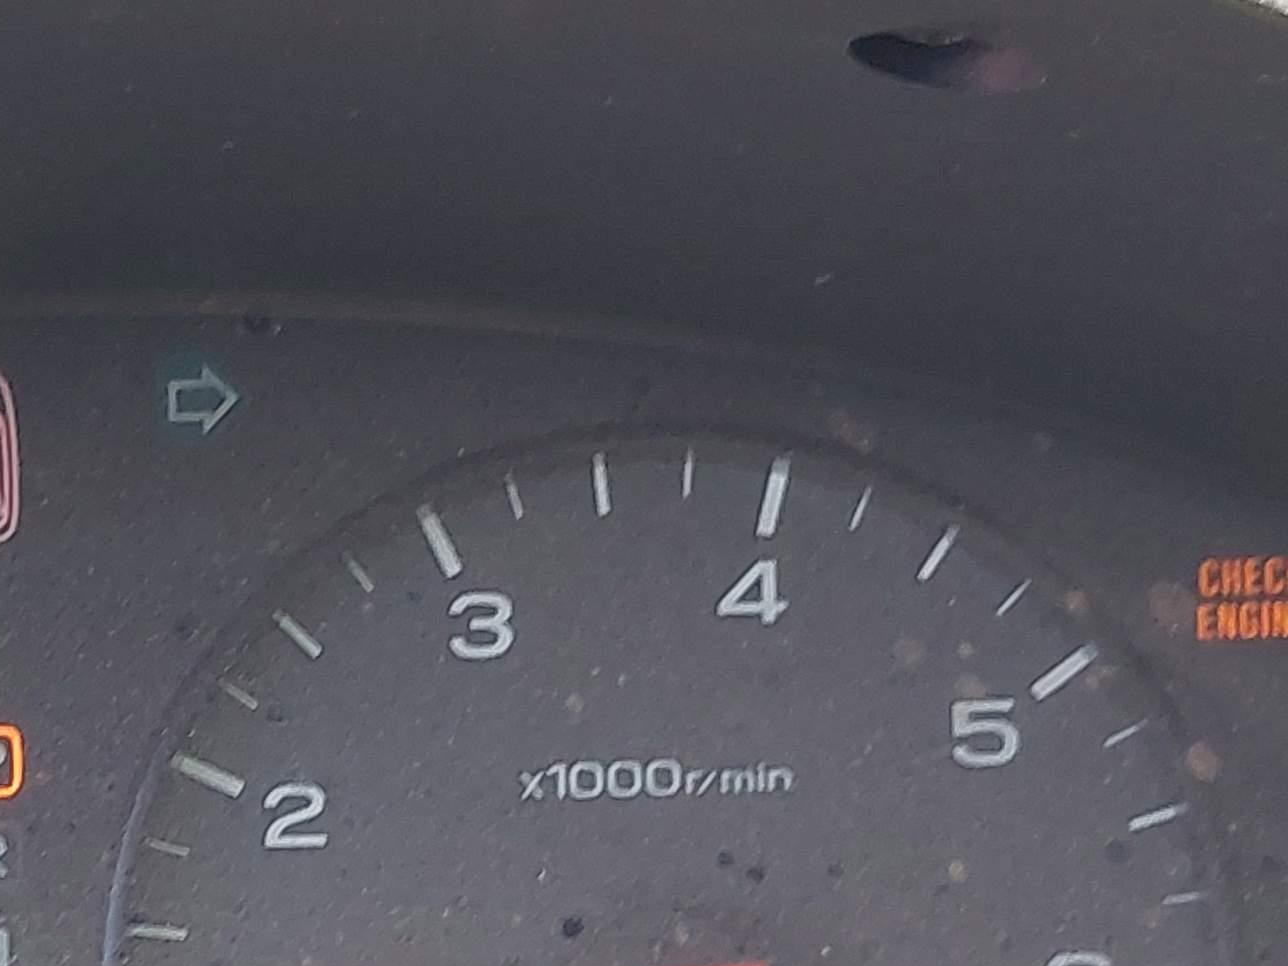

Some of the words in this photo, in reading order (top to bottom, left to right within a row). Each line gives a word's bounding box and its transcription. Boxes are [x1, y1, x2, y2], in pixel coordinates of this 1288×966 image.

[716, 559, 789, 626] 4
[1197, 557, 1288, 597] CHEC
[448, 589, 515, 659] 3
[950, 698, 1020, 768] 5
[263, 781, 329, 849] 2
